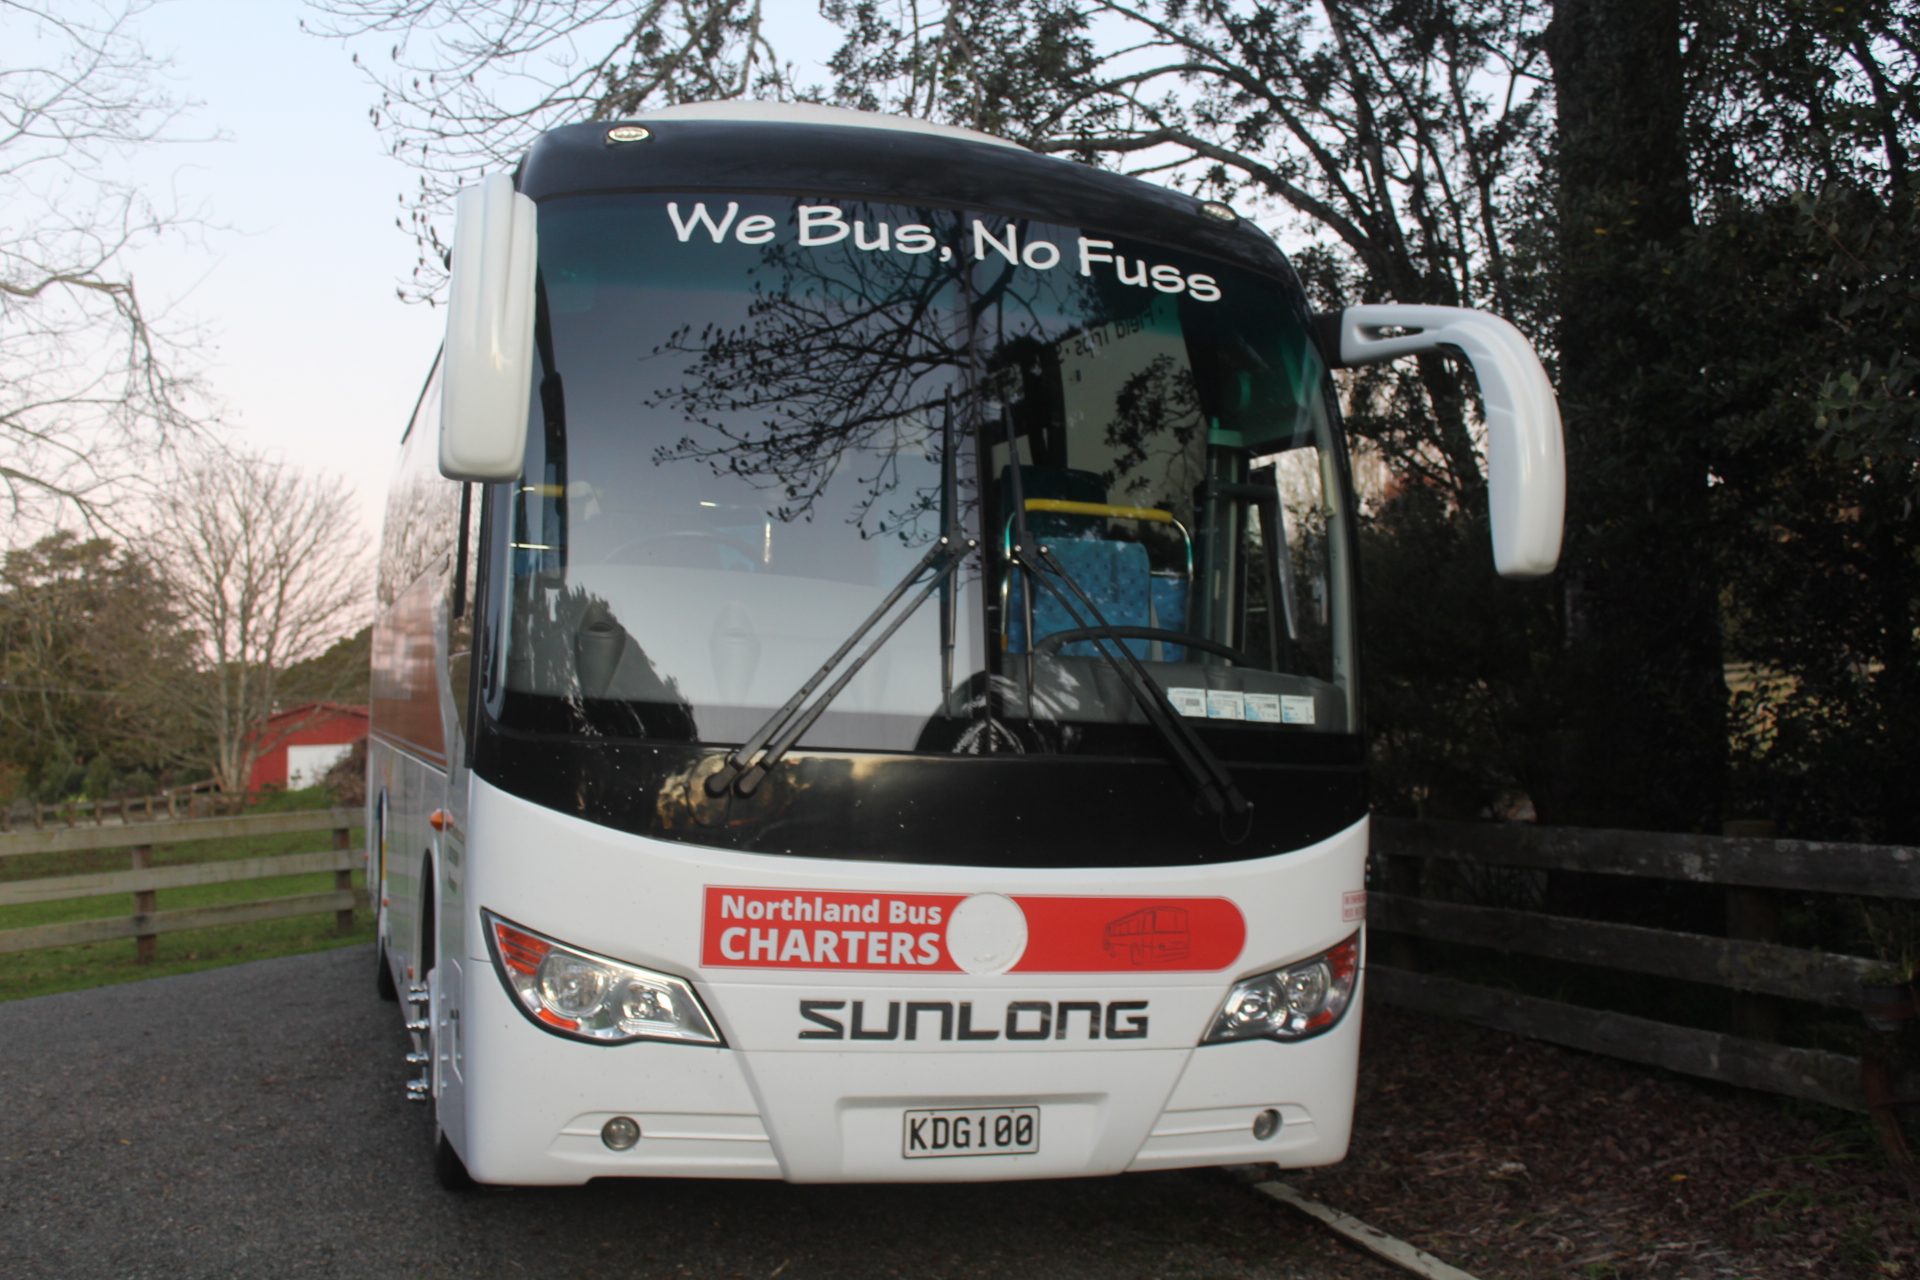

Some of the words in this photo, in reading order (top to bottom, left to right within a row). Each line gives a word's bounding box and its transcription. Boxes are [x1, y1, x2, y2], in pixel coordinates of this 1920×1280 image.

[666, 201, 776, 245] We
[798, 204, 952, 262] Bus,
[972, 219, 1061, 270] No
[1077, 236, 1222, 302] Fuss
[720, 894, 881, 923] Northland
[888, 899, 942, 925] Bus
[719, 926, 940, 965] CHARTERS
[798, 1000, 1149, 1041] SUNLONG
[910, 1114, 1033, 1150] KDG100
